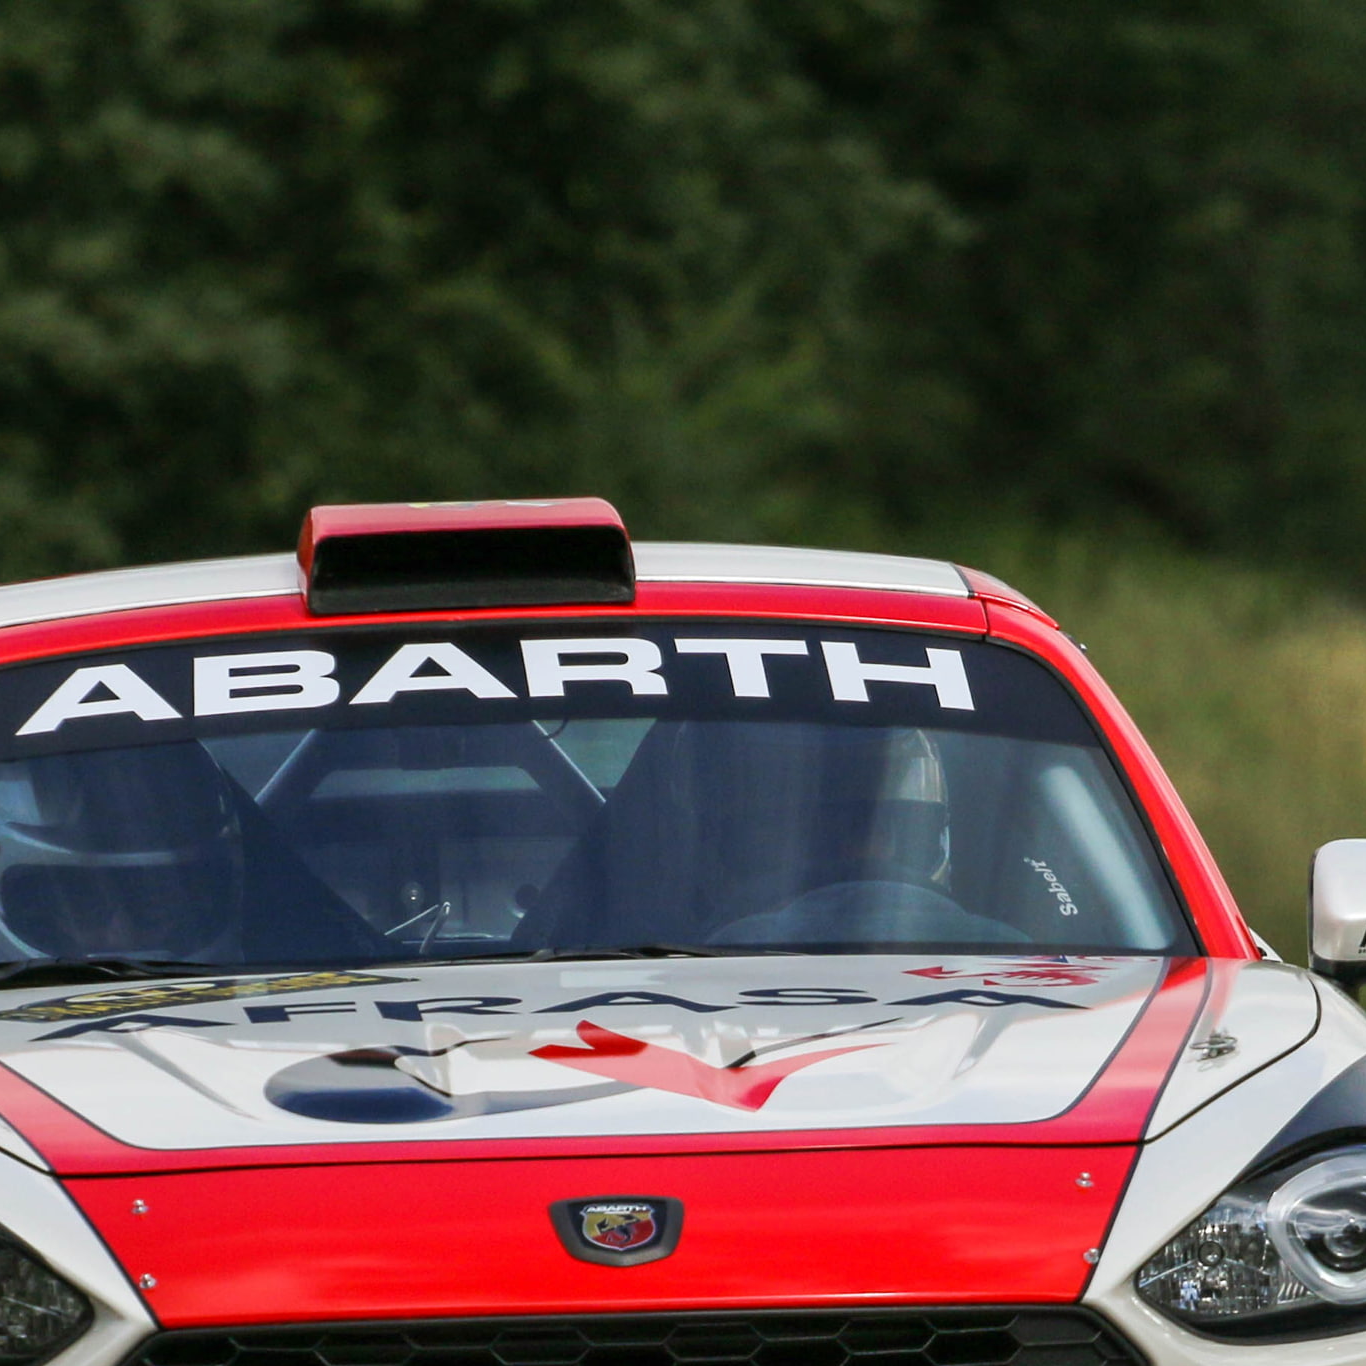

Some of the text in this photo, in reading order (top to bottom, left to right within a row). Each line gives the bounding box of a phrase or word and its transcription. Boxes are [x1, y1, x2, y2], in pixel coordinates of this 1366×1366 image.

[15, 636, 976, 737] ABARTH
[1029, 858, 1079, 917] Sabelt
[29, 987, 1090, 1043] AFRASA
[586, 1205, 648, 1213] ABARTH
